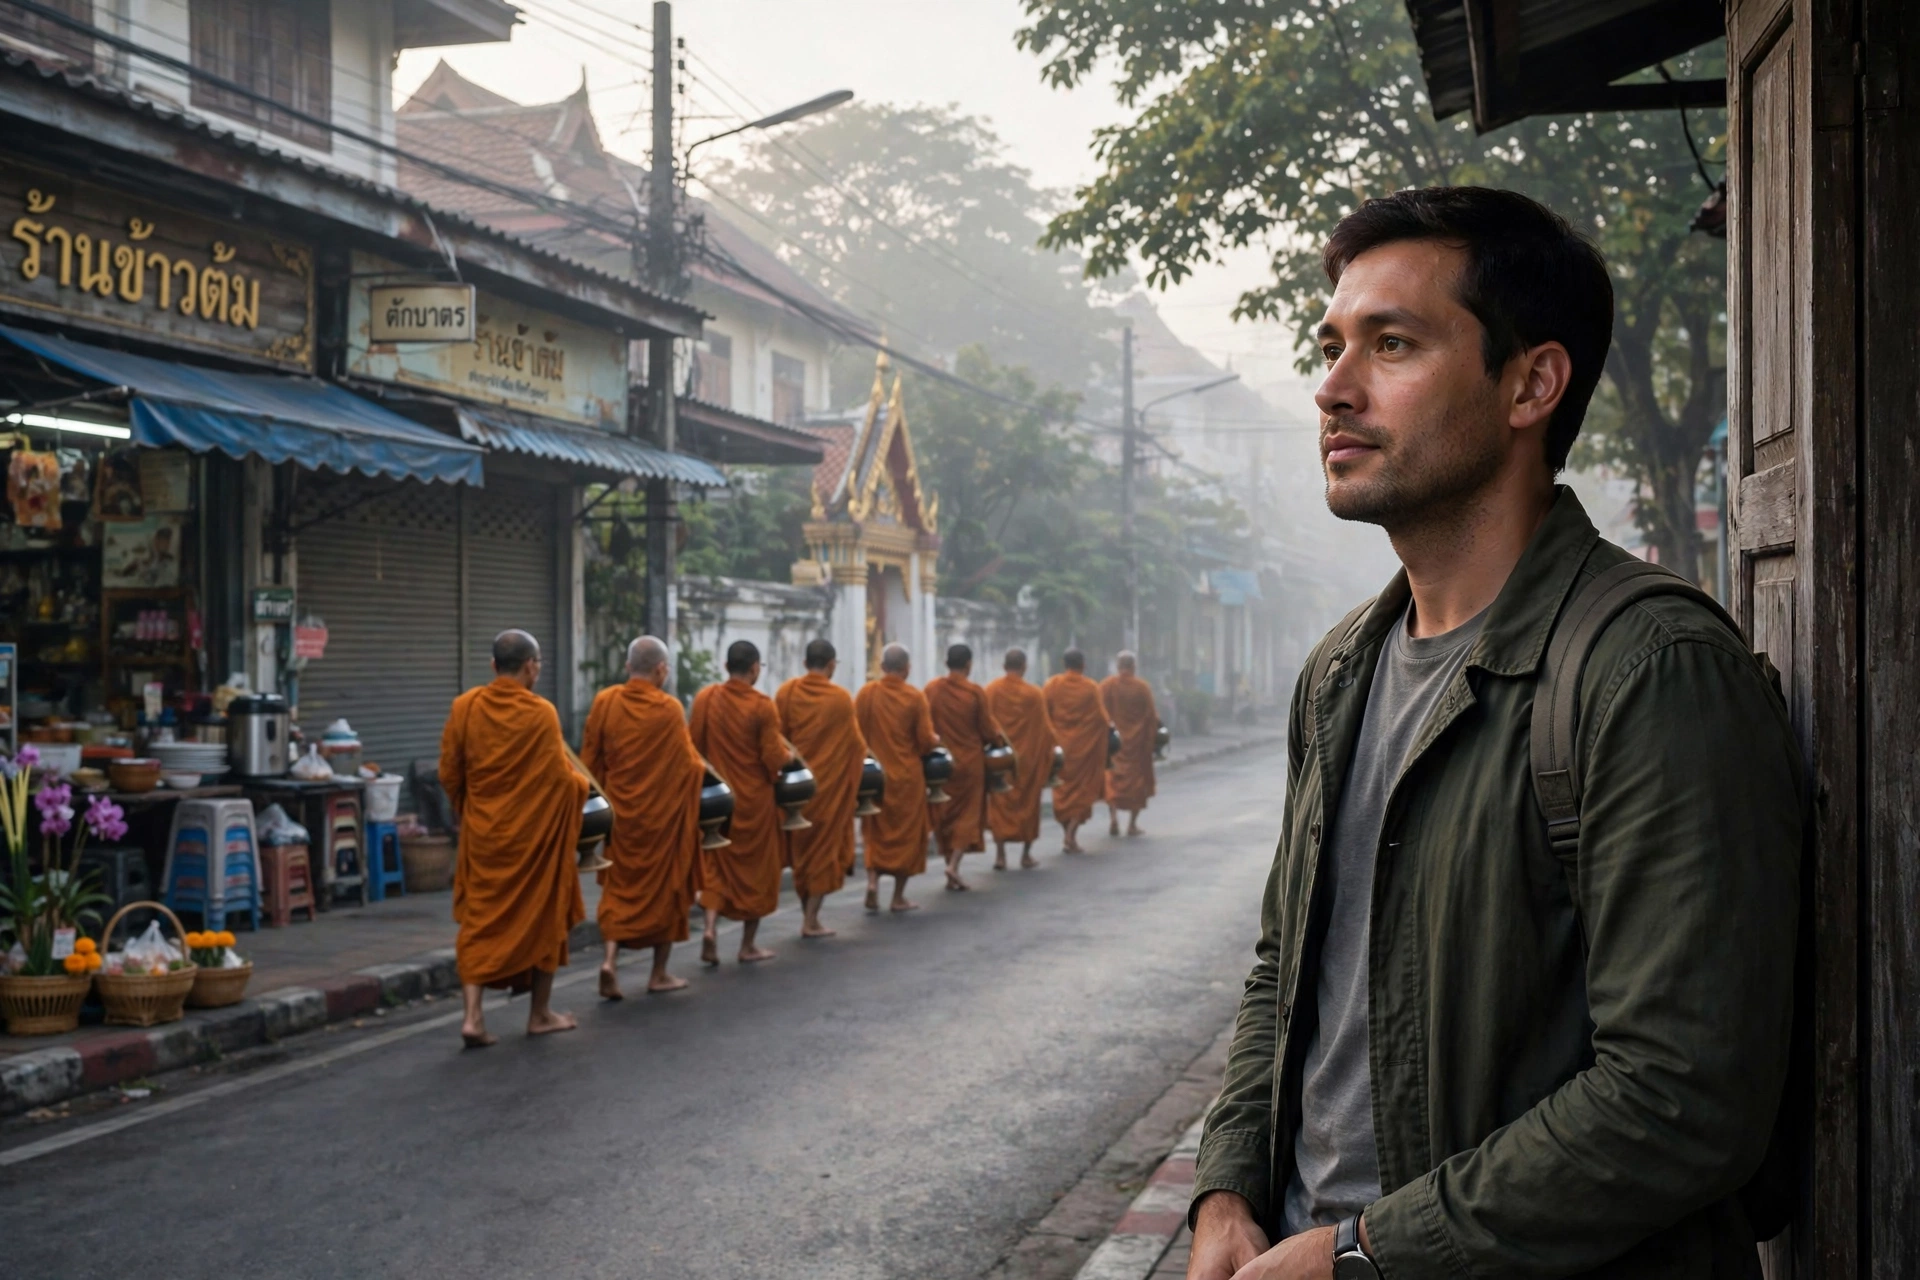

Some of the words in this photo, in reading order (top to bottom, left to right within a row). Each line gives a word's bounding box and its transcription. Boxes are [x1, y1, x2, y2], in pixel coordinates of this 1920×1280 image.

[13, 189, 260, 329] ร้านข้าวต้ม
